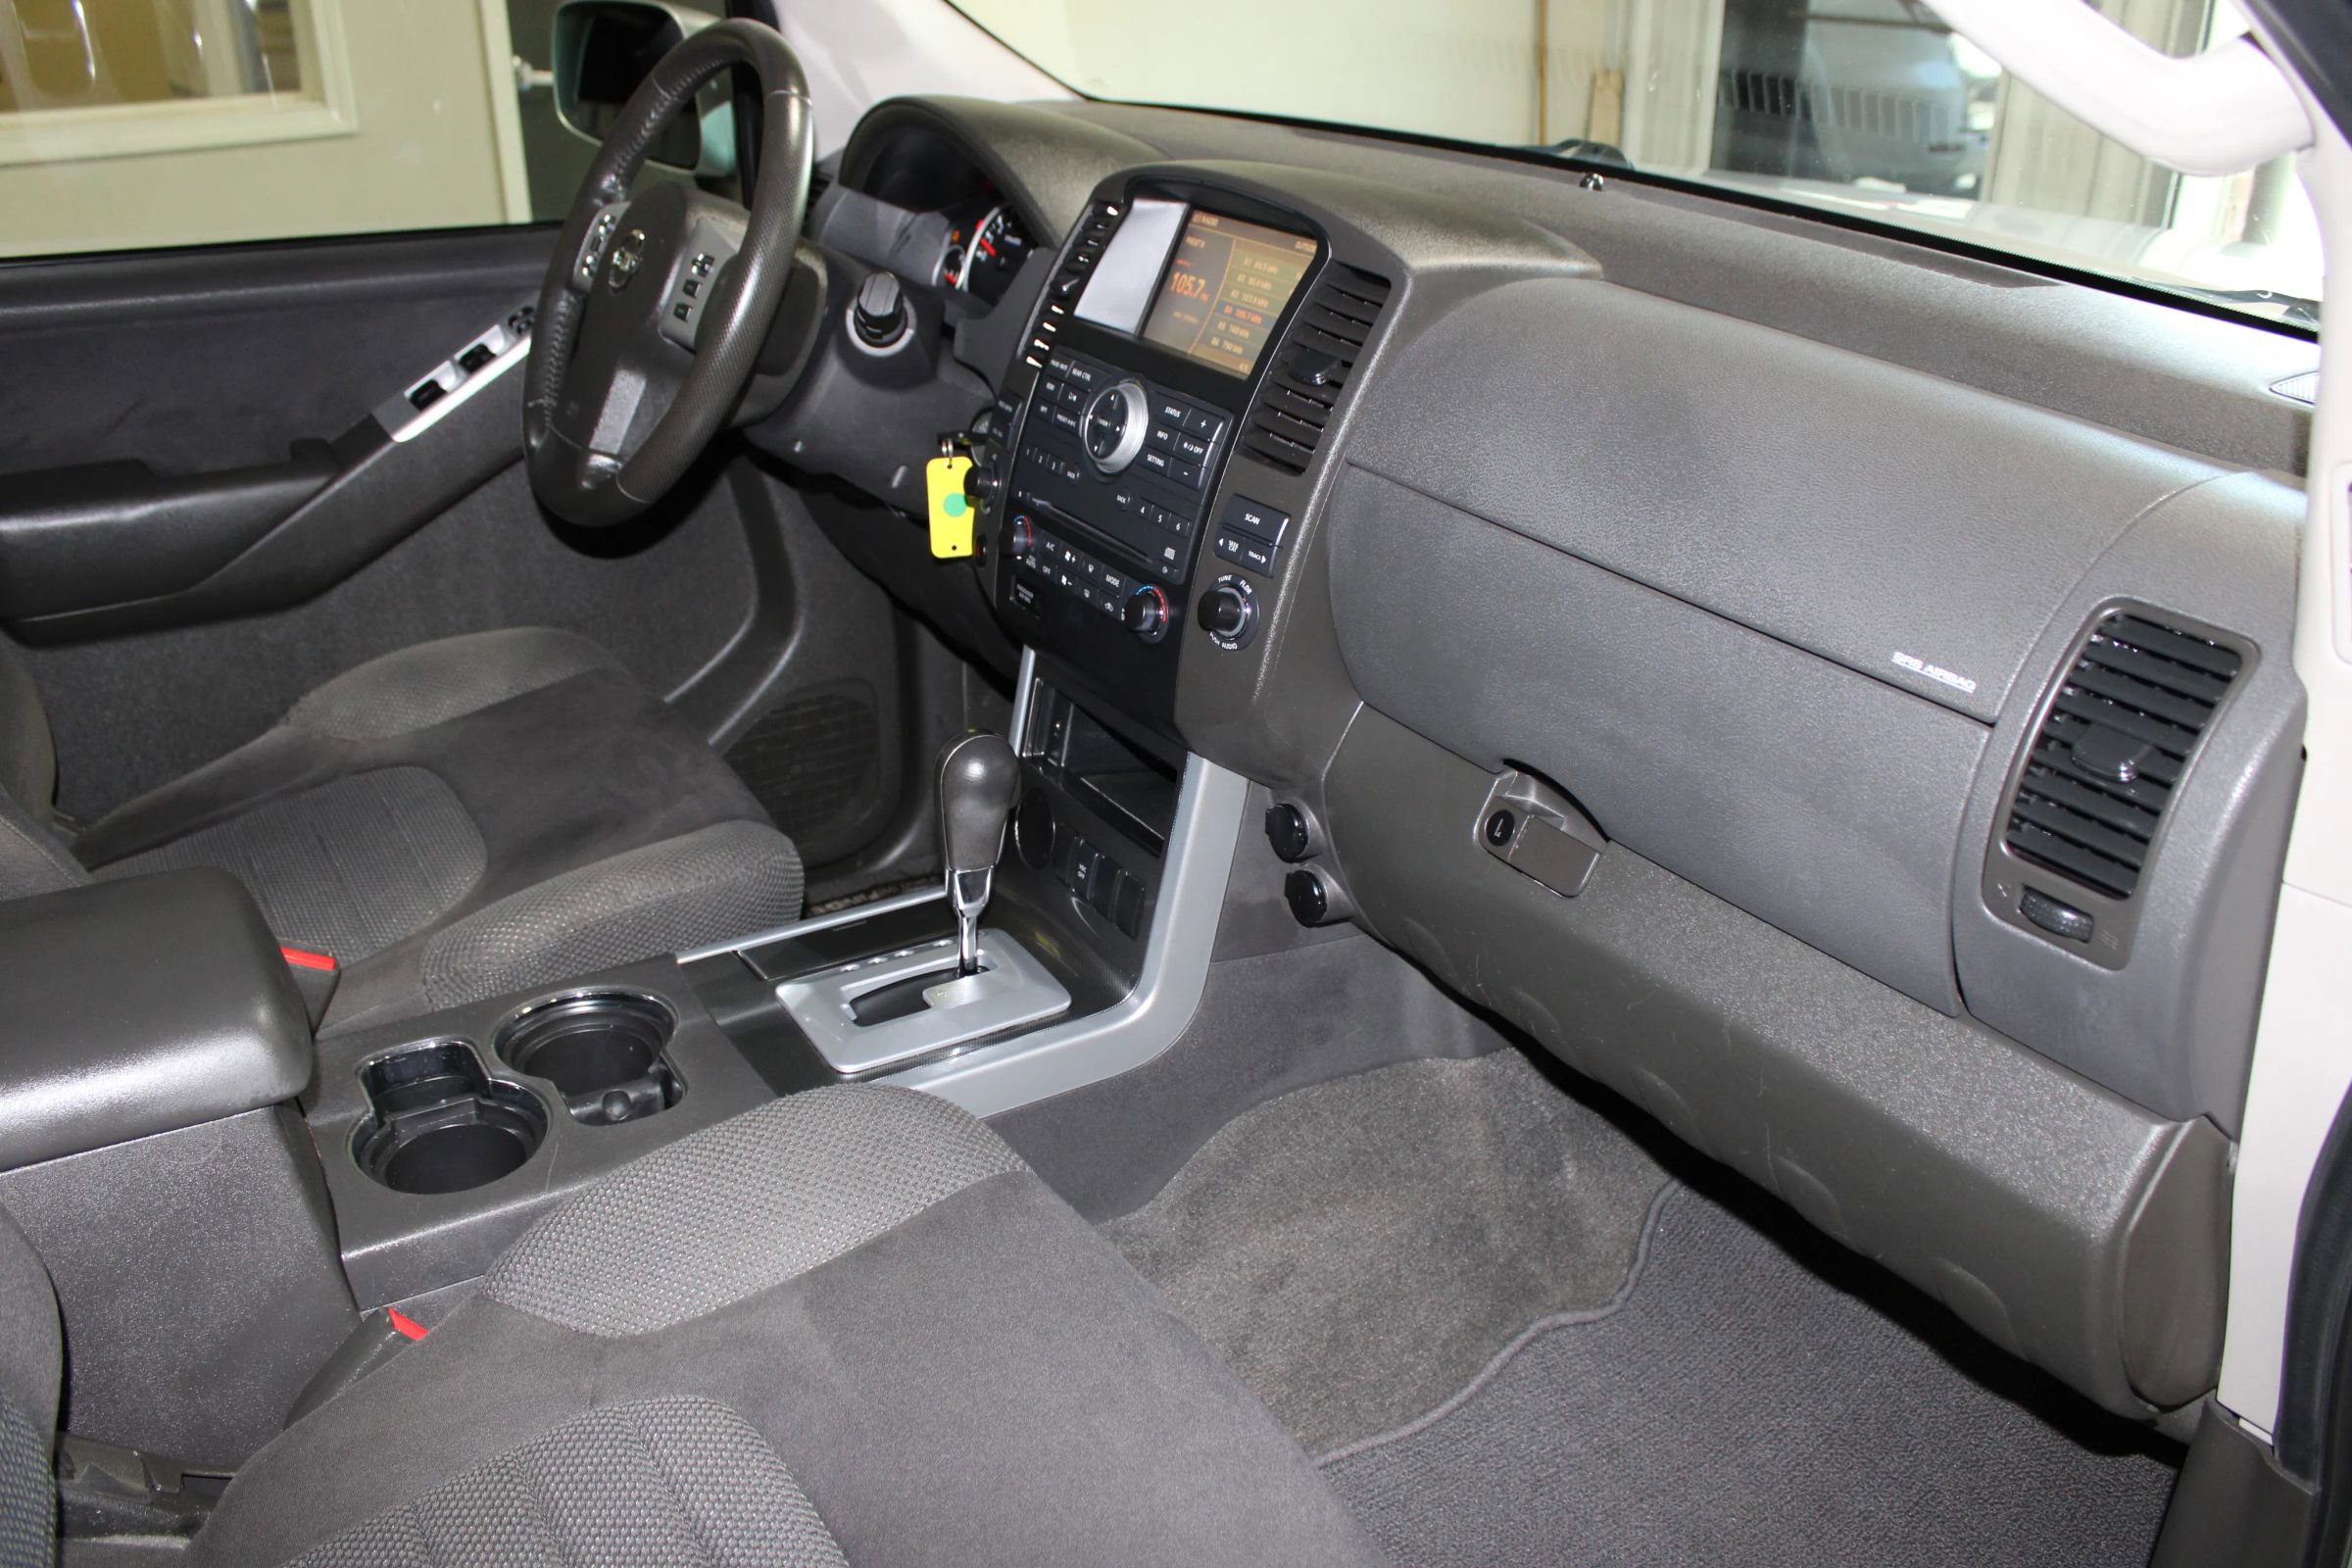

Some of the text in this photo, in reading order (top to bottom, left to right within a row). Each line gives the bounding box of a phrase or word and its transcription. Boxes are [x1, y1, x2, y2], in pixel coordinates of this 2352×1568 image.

[1170, 271, 1206, 298] 105.7
[1164, 406, 1181, 418] STATUS
[1156, 430, 1168, 440] INFO
[1193, 445, 1203, 455] OFF
[1147, 454, 1165, 467] SETTING
[1116, 494, 1126, 504] BACK
[1157, 514, 1162, 523] 5
[1244, 513, 1260, 525] SCAN
[1046, 542, 1055, 552] A/C
[1105, 573, 1121, 588] MODE
[1218, 574, 1232, 583] TUNE
[1221, 642, 1238, 651] AUDIO
